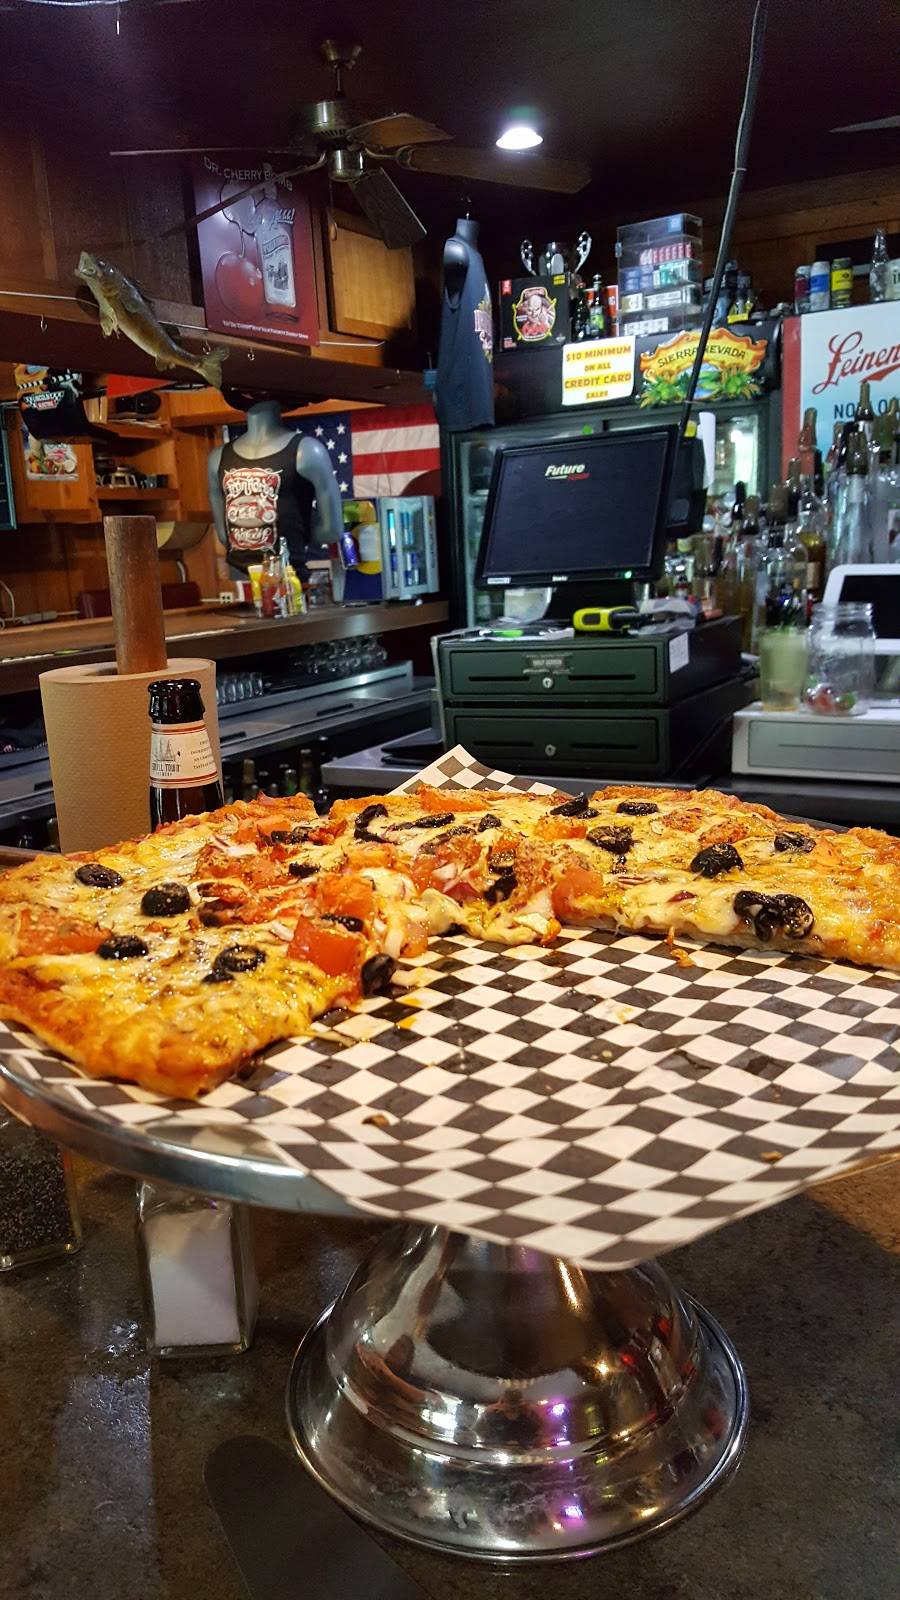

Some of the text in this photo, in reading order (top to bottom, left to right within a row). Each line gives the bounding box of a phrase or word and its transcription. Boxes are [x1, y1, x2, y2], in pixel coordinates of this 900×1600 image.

[203, 156, 222, 176] DR.
[223, 168, 263, 181] CHERRY
[566, 345, 631, 362] $10 MINIMUM
[657, 346, 698, 368] SIERRA
[584, 362, 611, 372] ON ALL
[564, 373, 632, 389] CREDIT CARD
[586, 390, 609, 399] SALES
[834, 402, 856, 419] NO
[544, 464, 586, 477] Future
